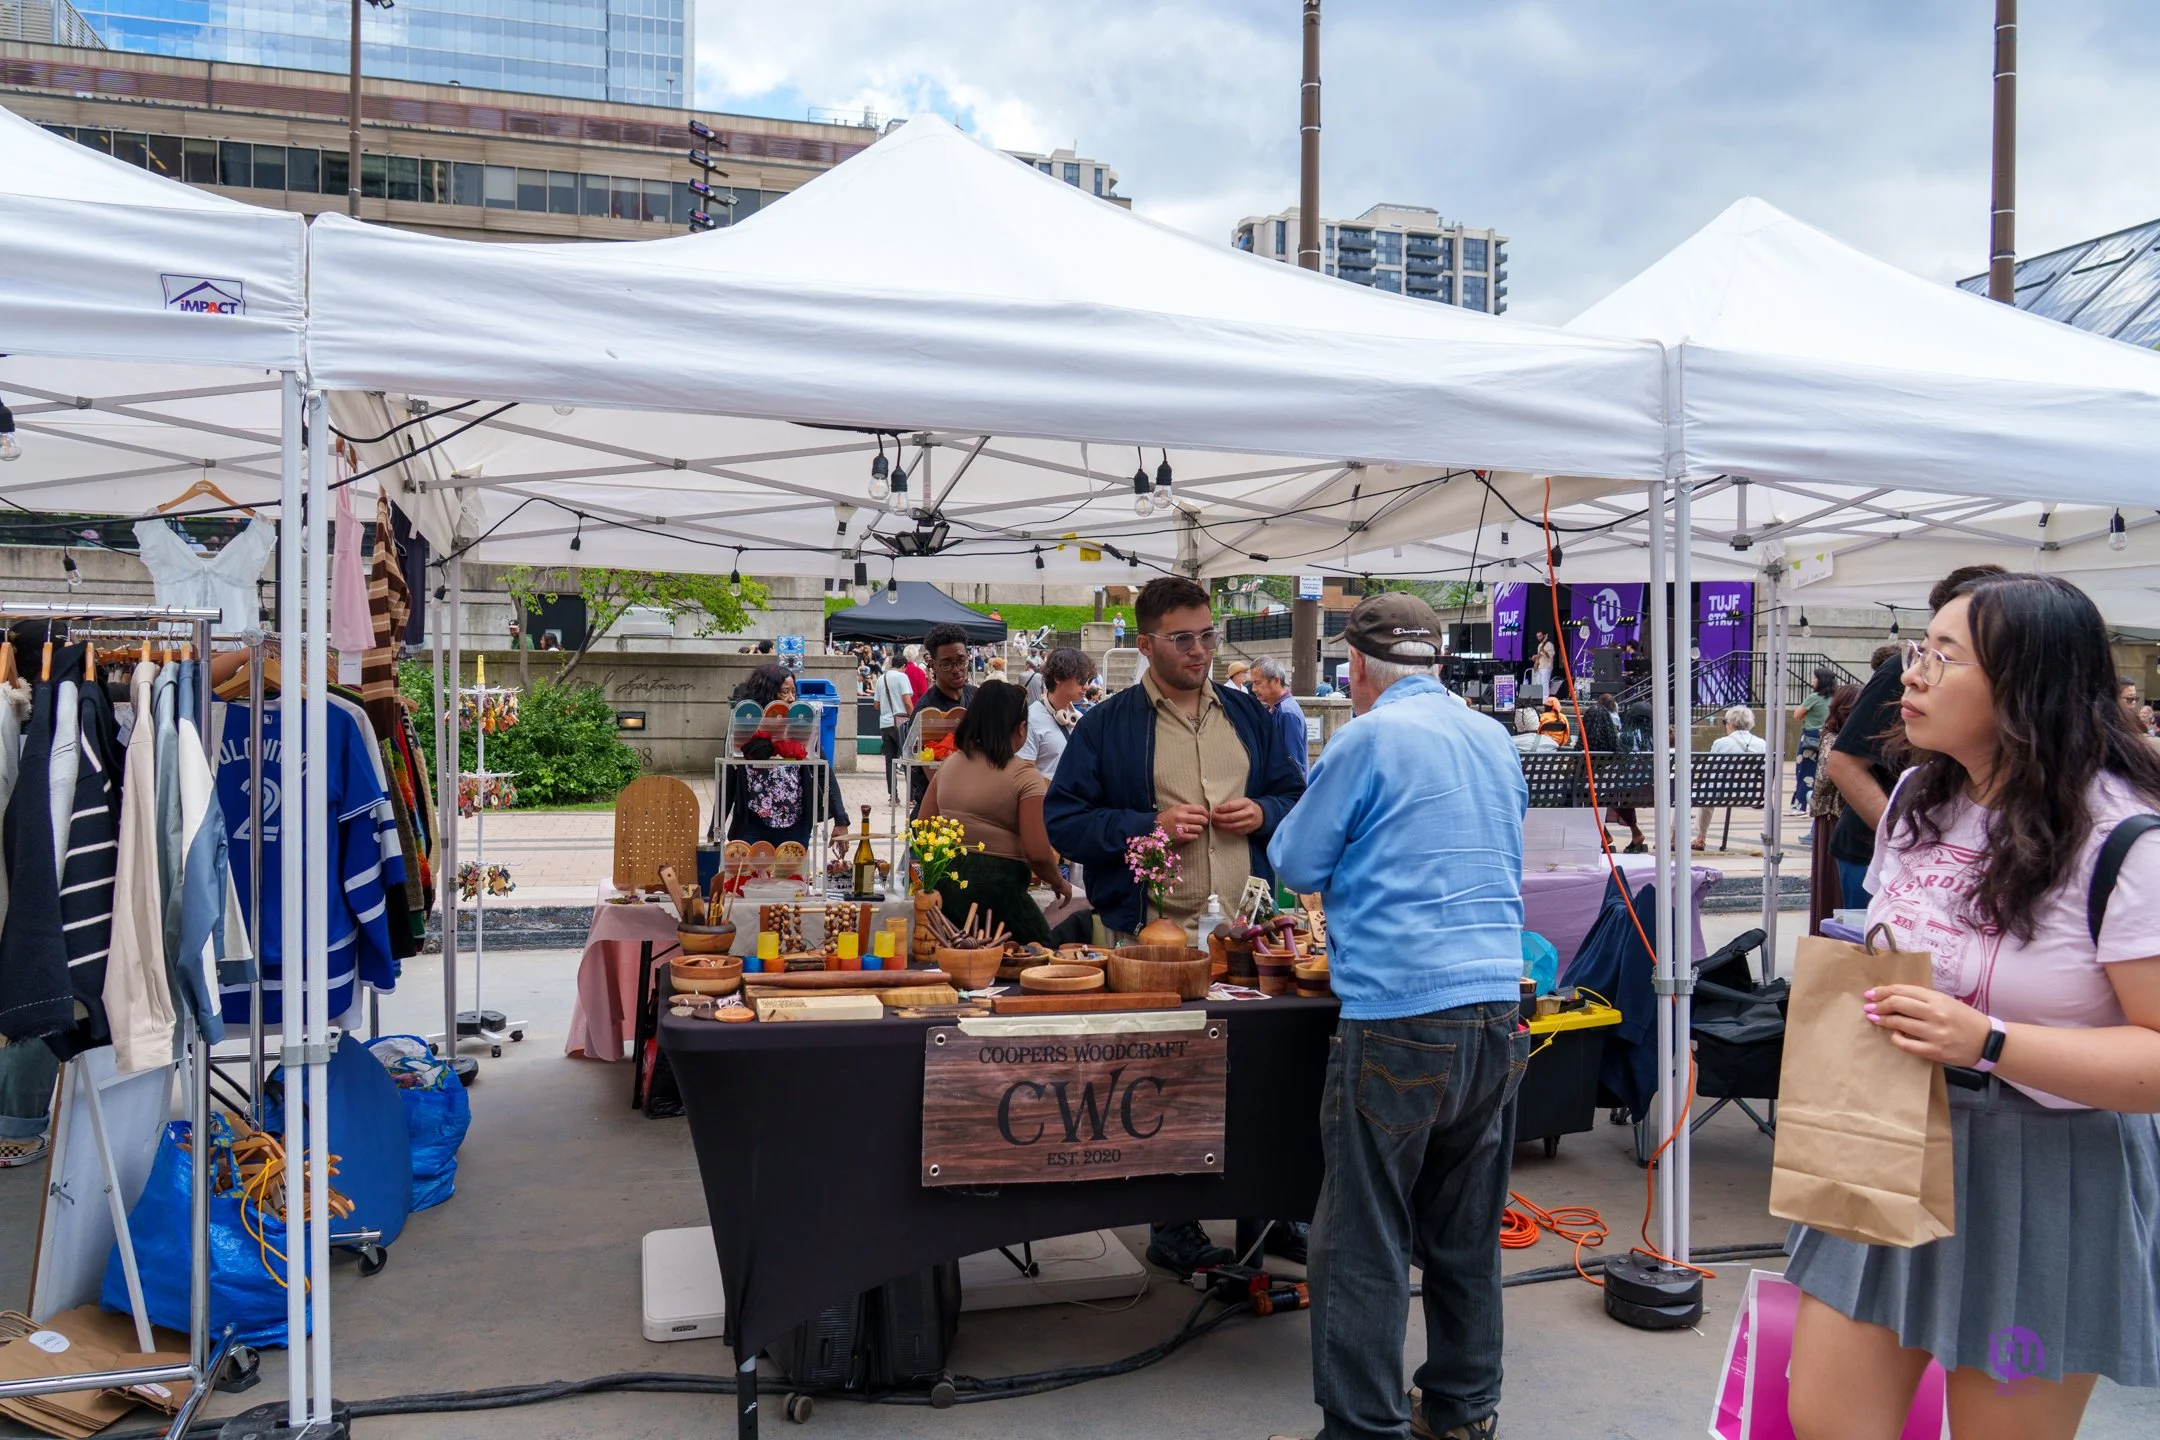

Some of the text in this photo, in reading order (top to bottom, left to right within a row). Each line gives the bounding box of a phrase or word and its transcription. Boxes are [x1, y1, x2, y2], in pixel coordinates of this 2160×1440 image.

[1708, 594, 1741, 611] TUJF
[1498, 610, 1519, 625] TUJF
[979, 1041, 1189, 1064] COOPERS WOODCRAFT
[998, 1064, 1167, 1146] CWC
[1047, 1150, 1122, 1166] EST. 2020
